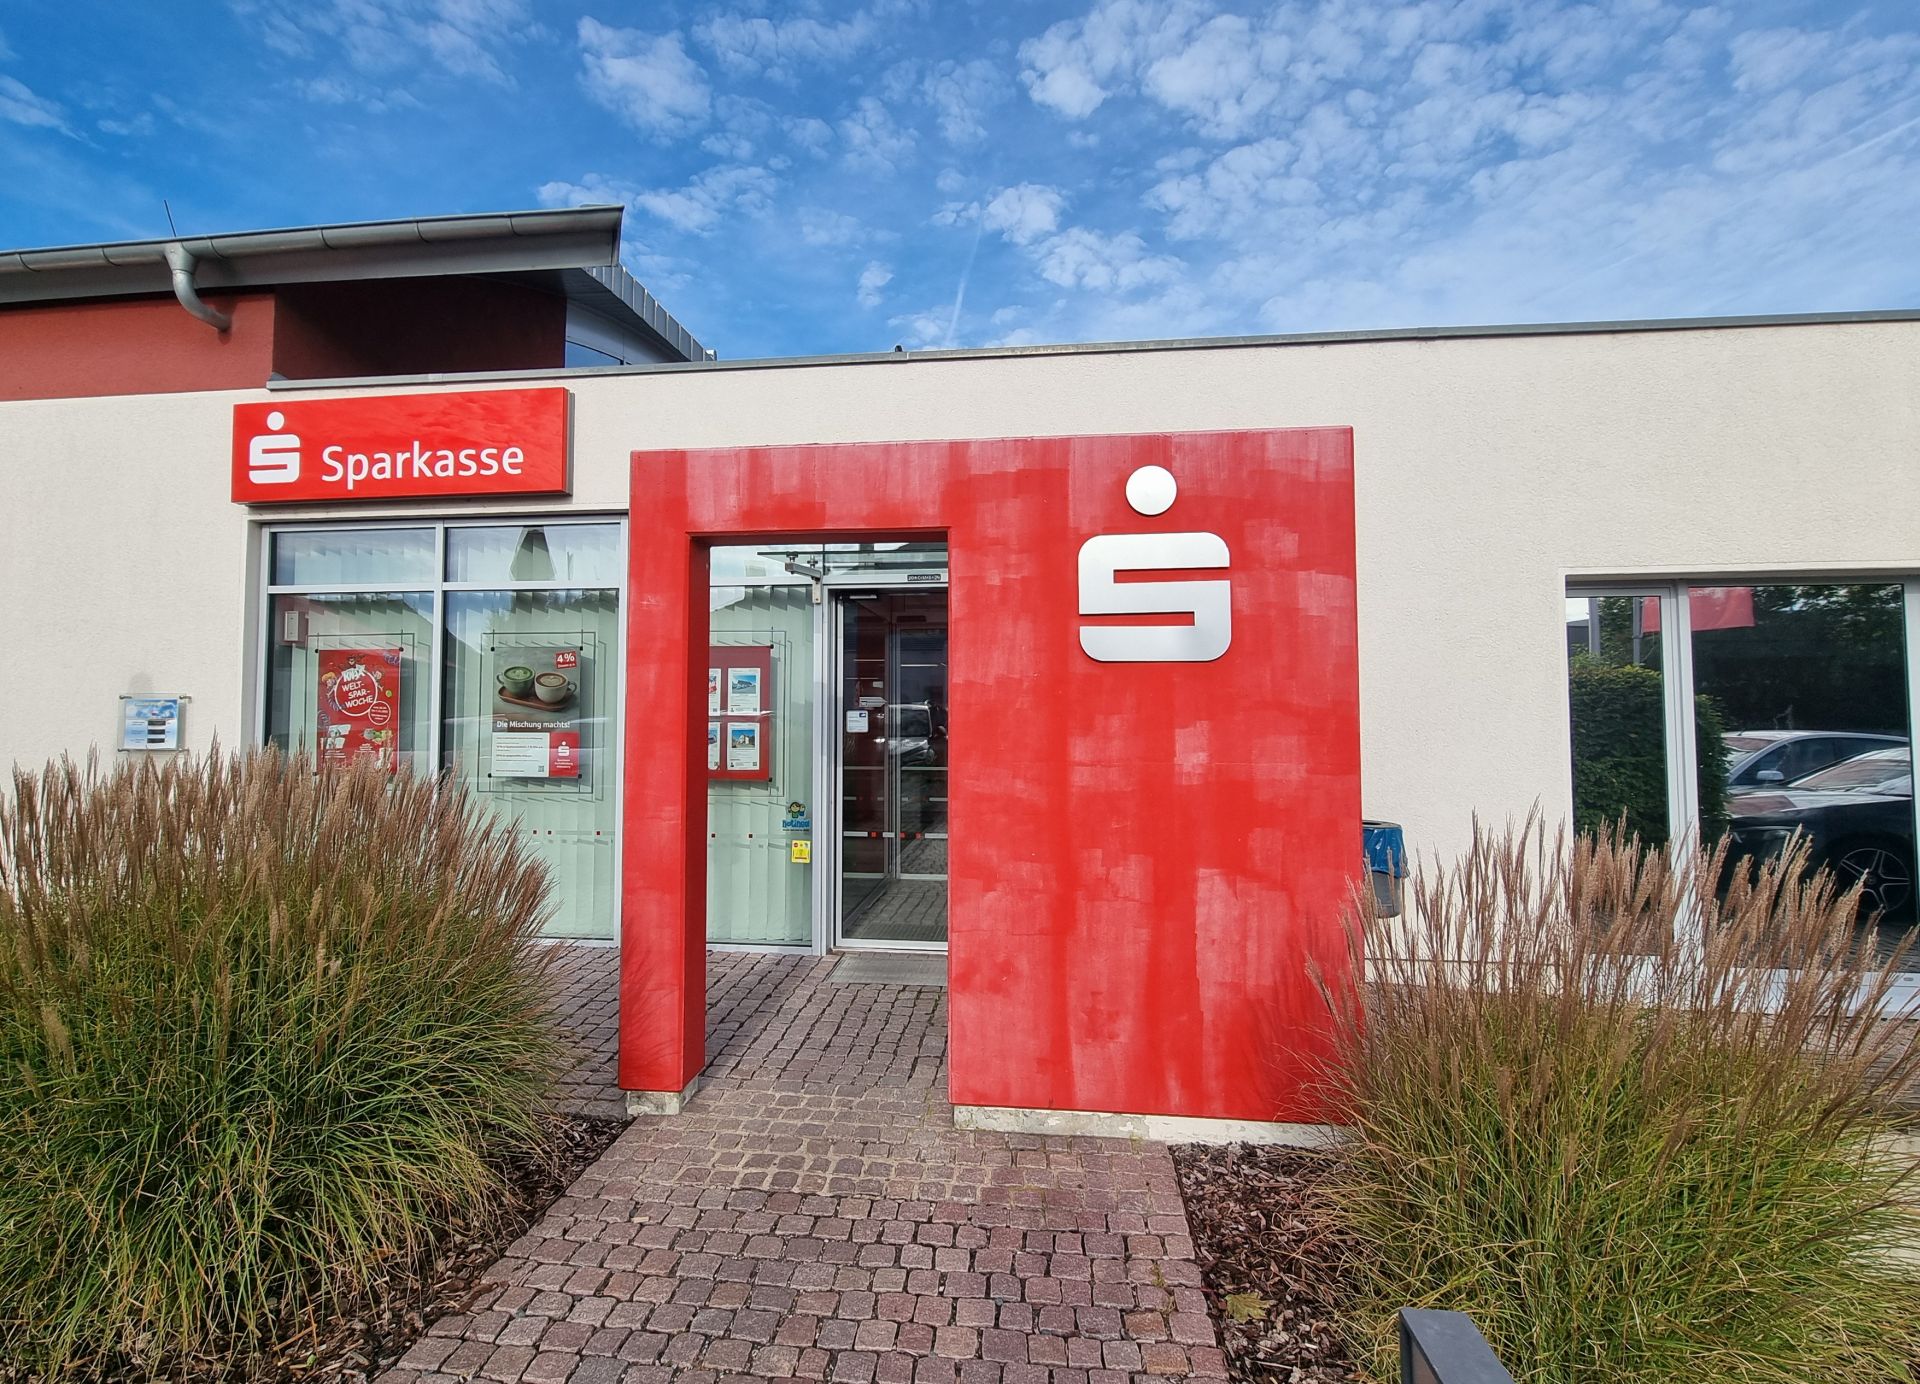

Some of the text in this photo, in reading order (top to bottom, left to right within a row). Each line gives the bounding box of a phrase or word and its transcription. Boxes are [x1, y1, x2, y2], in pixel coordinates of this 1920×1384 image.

[321, 440, 524, 490] Sparkasse
[342, 680, 365, 691] WELT-
[348, 688, 370, 699] SPAR-
[344, 695, 373, 708] WOCHE
[496, 720, 571, 730] Die Mischung machts!
